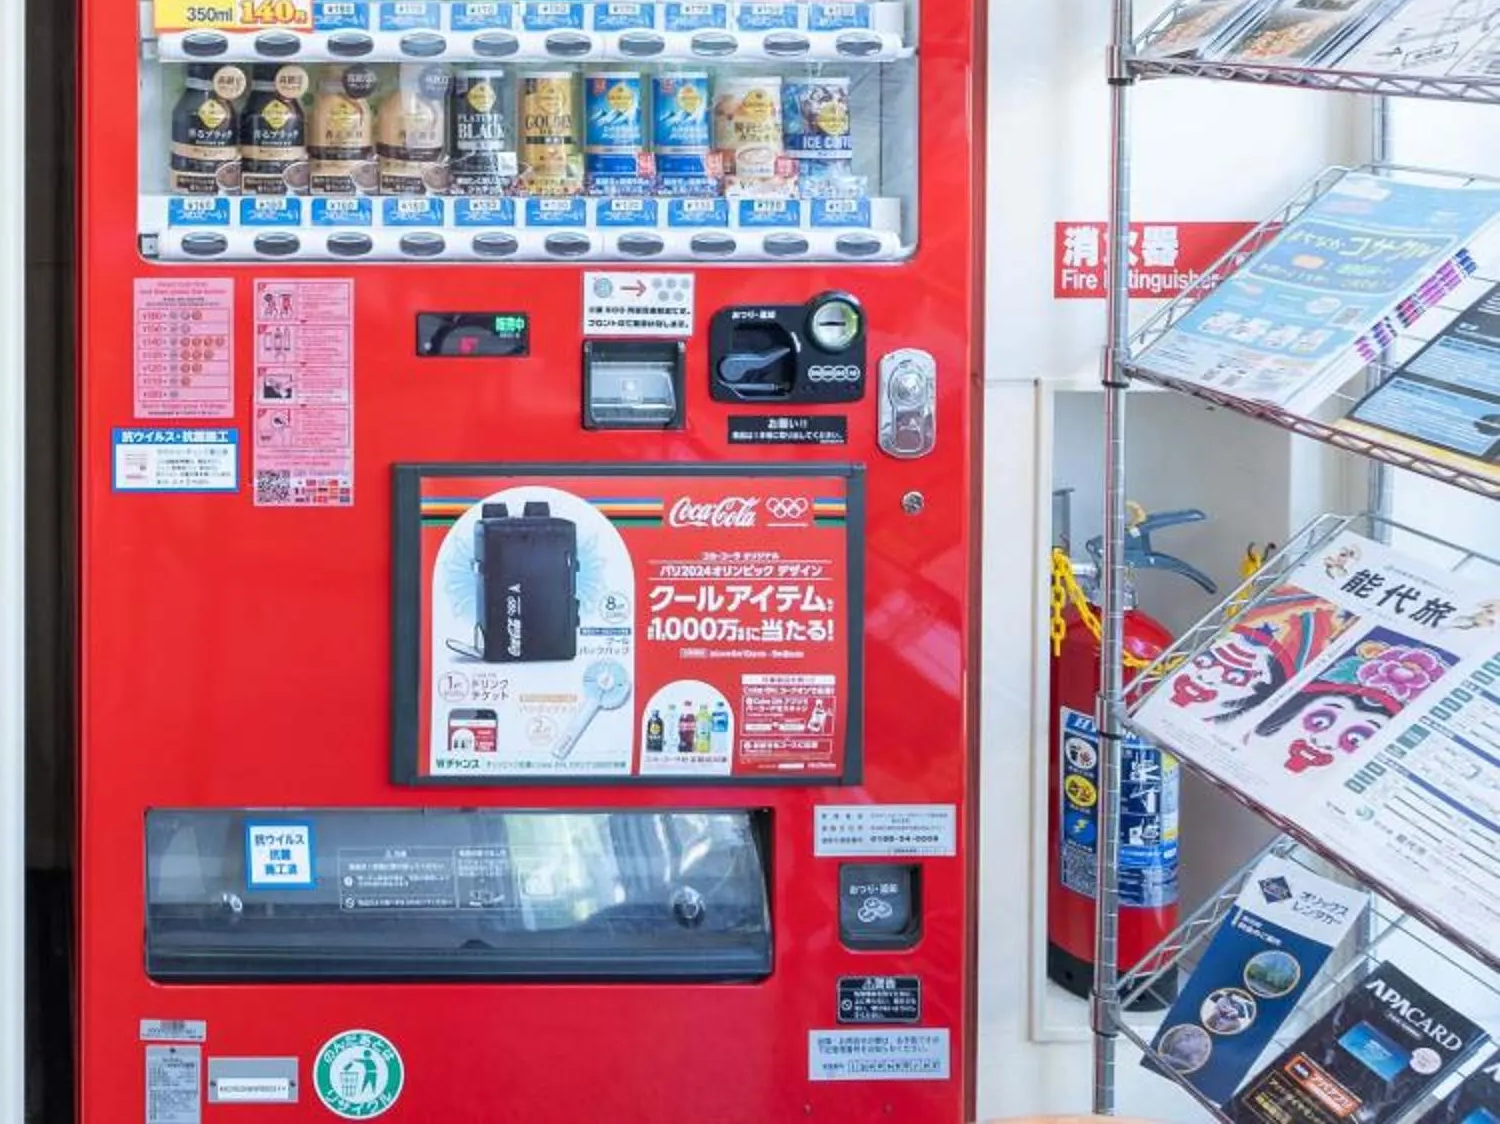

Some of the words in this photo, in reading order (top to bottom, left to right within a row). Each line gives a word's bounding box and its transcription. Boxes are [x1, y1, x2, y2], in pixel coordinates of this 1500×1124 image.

[187, 7, 233, 22] 350ml
[1062, 225, 1180, 267] 消器
[1061, 269, 1099, 289] Fire
[668, 496, 760, 527] Coca-Cola
[1340, 569, 1457, 628] 能代旅
[254, 834, 305, 846] 抗ウイルス
[1291, 900, 1342, 925] レンタカー
[1300, 891, 1349, 916] オリックス
[1364, 978, 1463, 1052] APACARD
